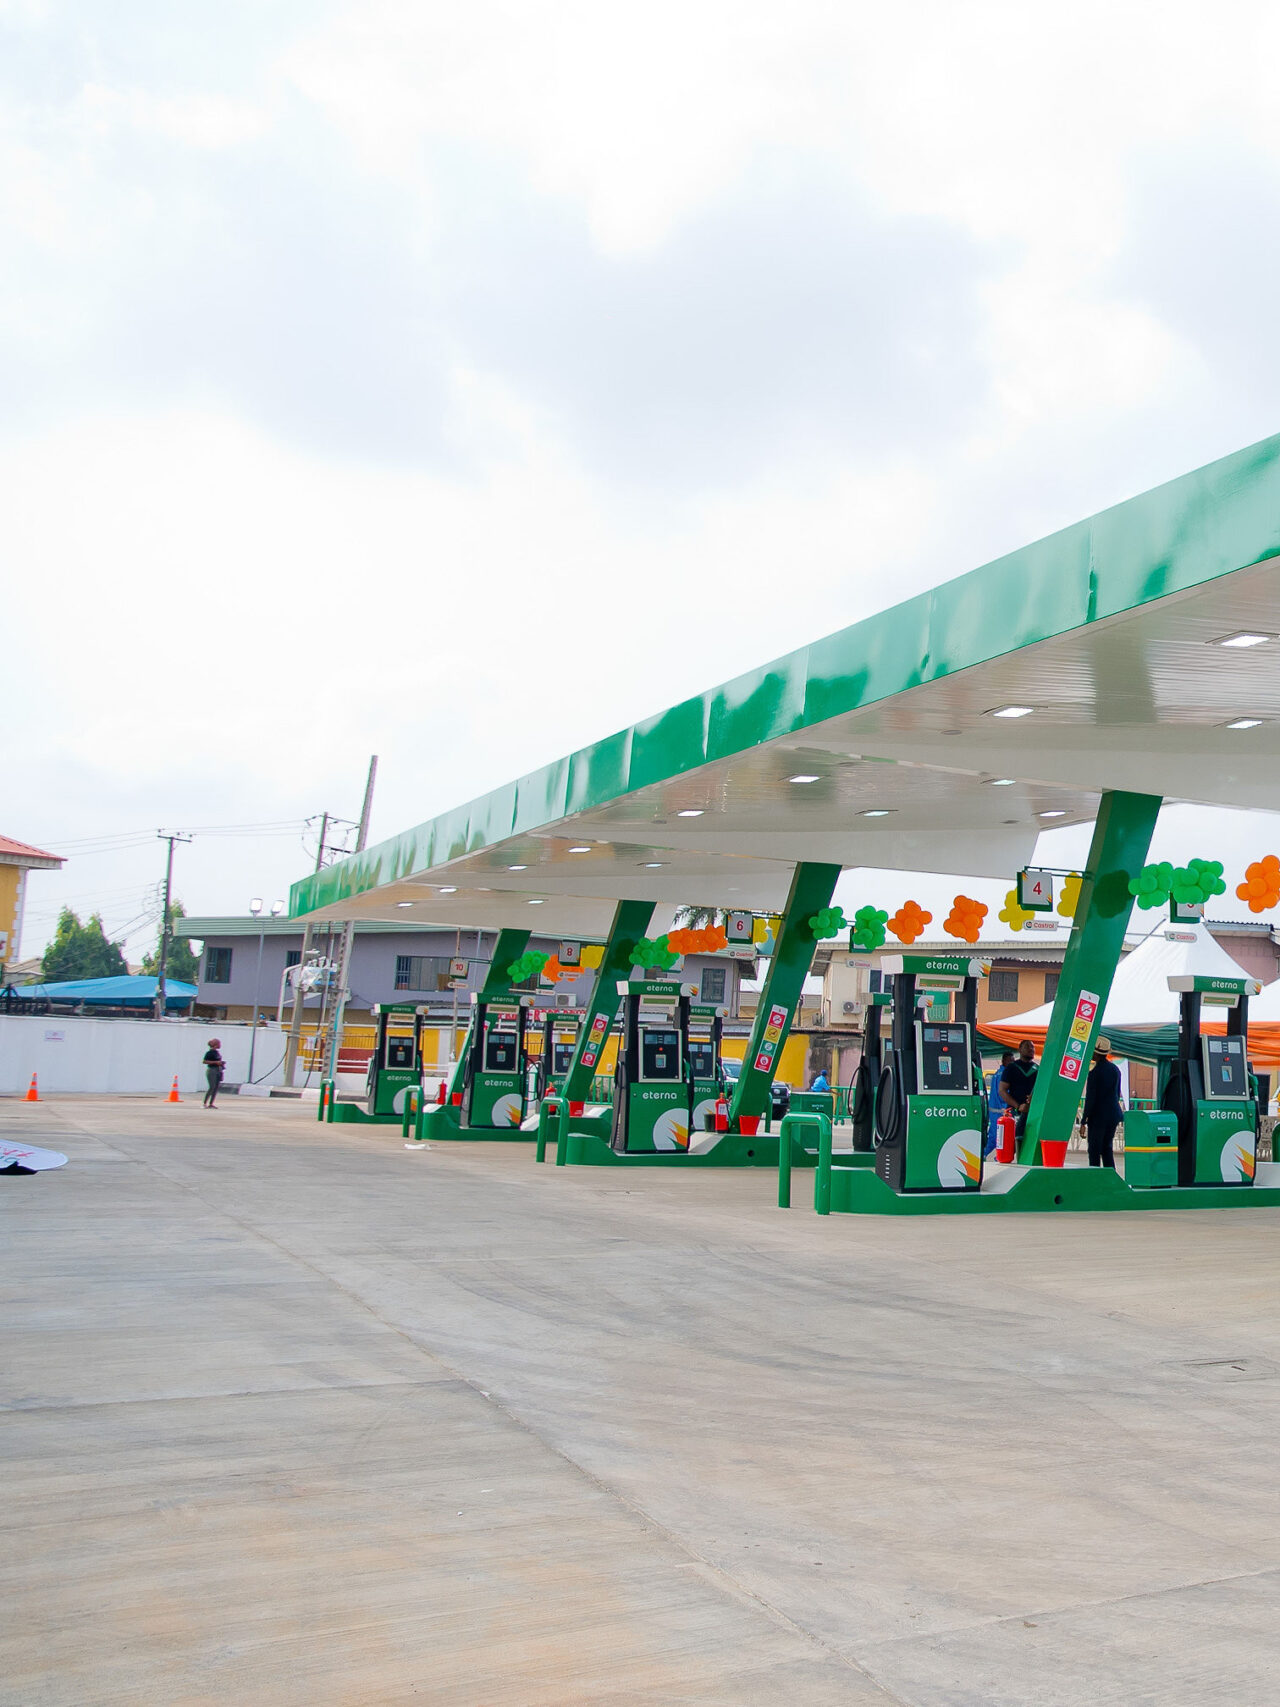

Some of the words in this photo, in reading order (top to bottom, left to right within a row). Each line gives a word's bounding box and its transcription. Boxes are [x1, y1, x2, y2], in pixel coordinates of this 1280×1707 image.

[1032, 881, 1042, 896] 4
[736, 920, 744, 931] 6
[566, 947, 574, 956] 8
[925, 961, 960, 971] eterna
[1211, 980, 1238, 989] eterna
[484, 1079, 514, 1087] eterna
[642, 1091, 678, 1100] eterna
[925, 1106, 967, 1117] eterna
[1209, 1110, 1244, 1120] eterna
